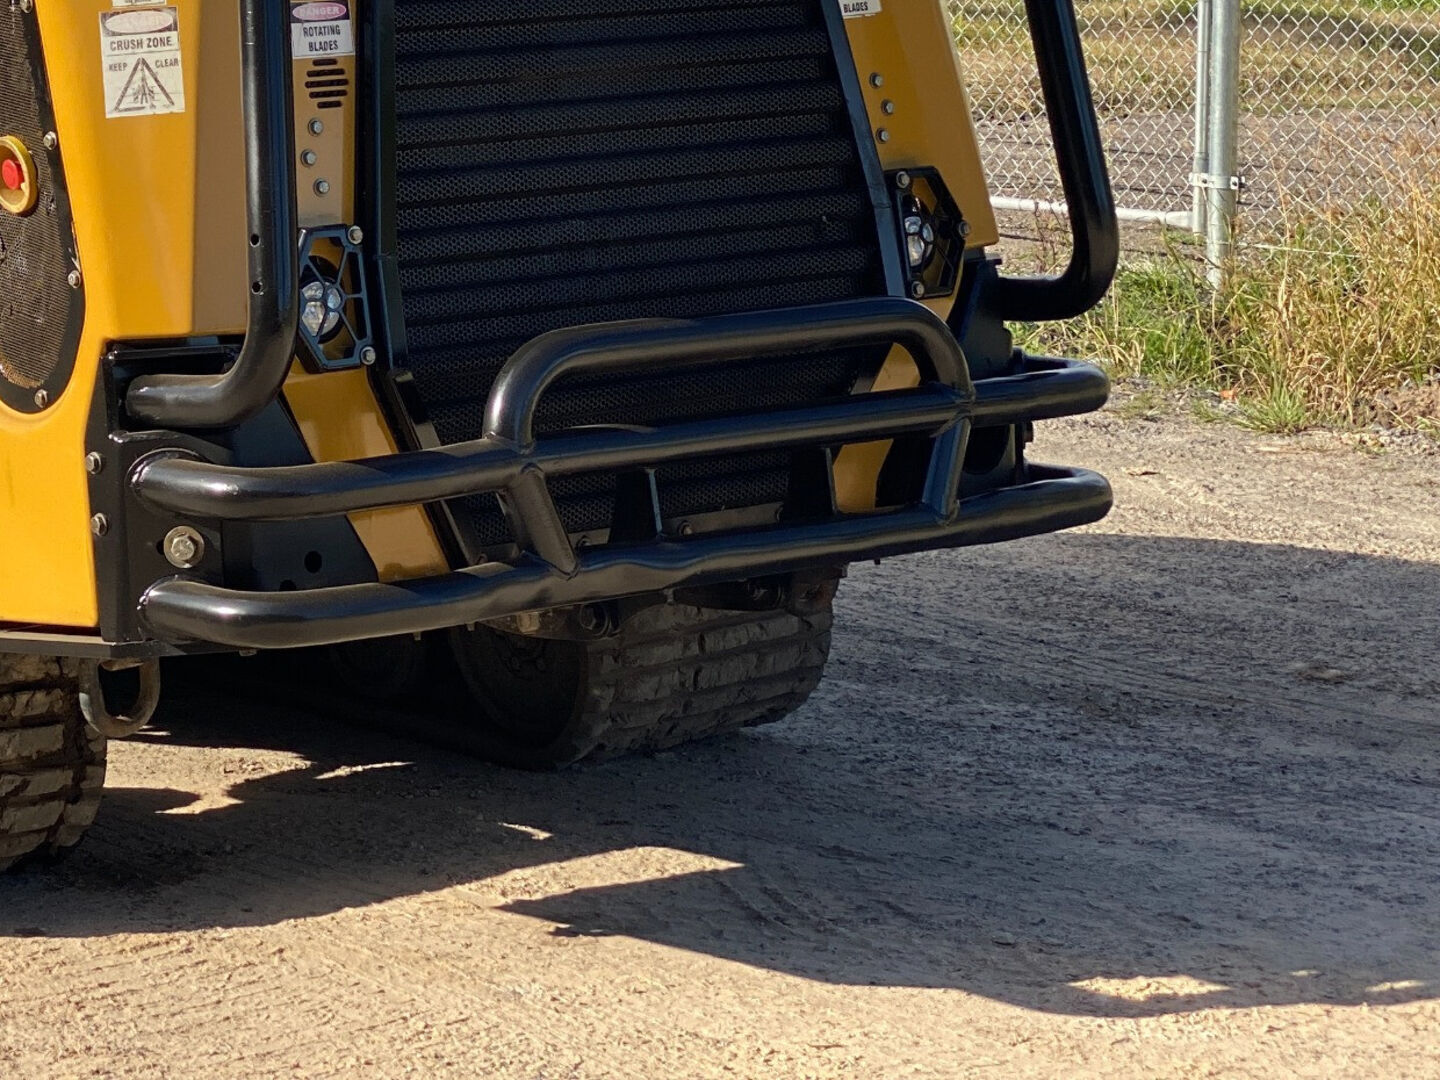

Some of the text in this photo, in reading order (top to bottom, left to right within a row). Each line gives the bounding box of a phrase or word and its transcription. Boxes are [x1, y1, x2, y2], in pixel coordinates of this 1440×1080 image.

[843, 1, 868, 13] BLADES
[303, 24, 340, 38] ROTATING
[109, 36, 173, 51] CRUSH ZONE
[308, 40, 339, 52] BLADES
[108, 58, 179, 72] KEEP CLEAR
